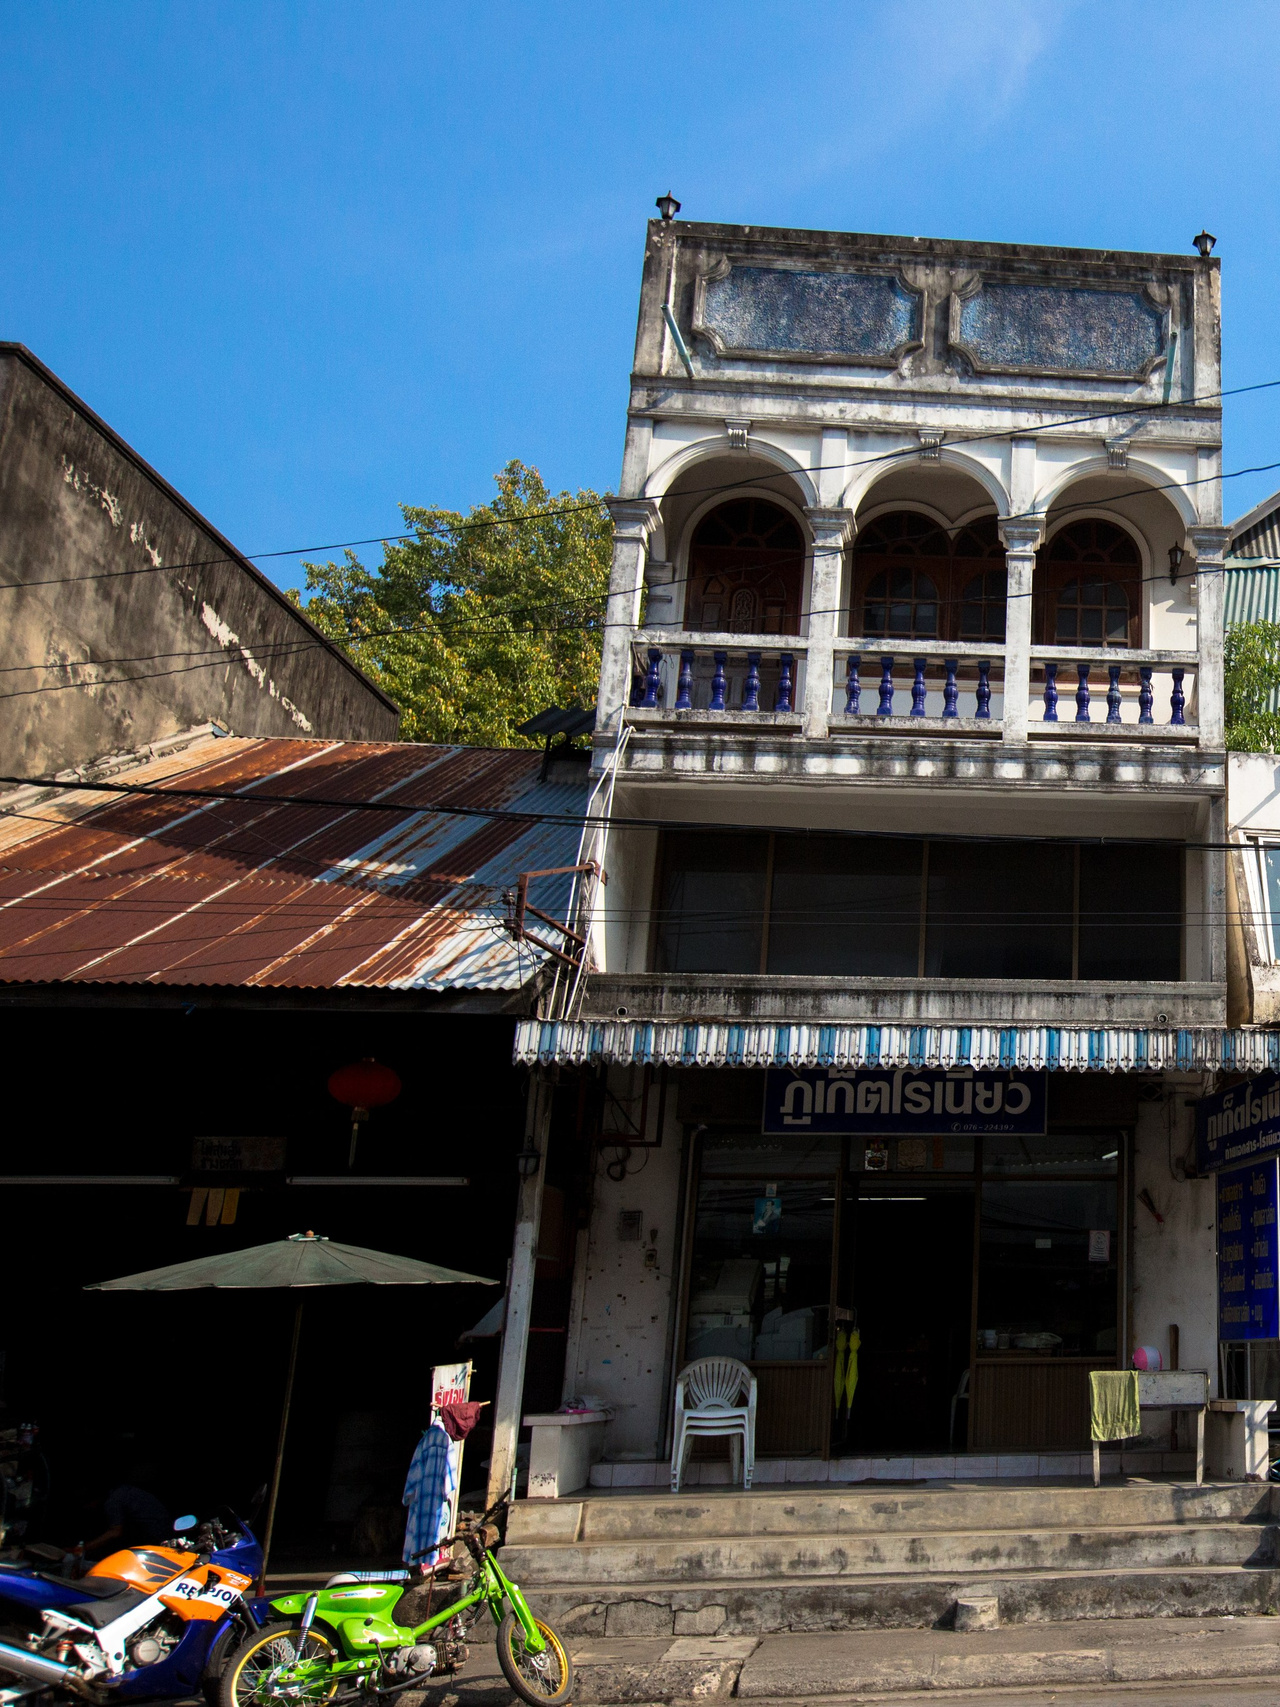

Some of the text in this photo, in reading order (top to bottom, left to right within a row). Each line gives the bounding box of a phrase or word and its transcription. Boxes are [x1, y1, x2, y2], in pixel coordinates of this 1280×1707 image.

[780, 1069, 1032, 1125] ภูเก็ตโรเนียว
